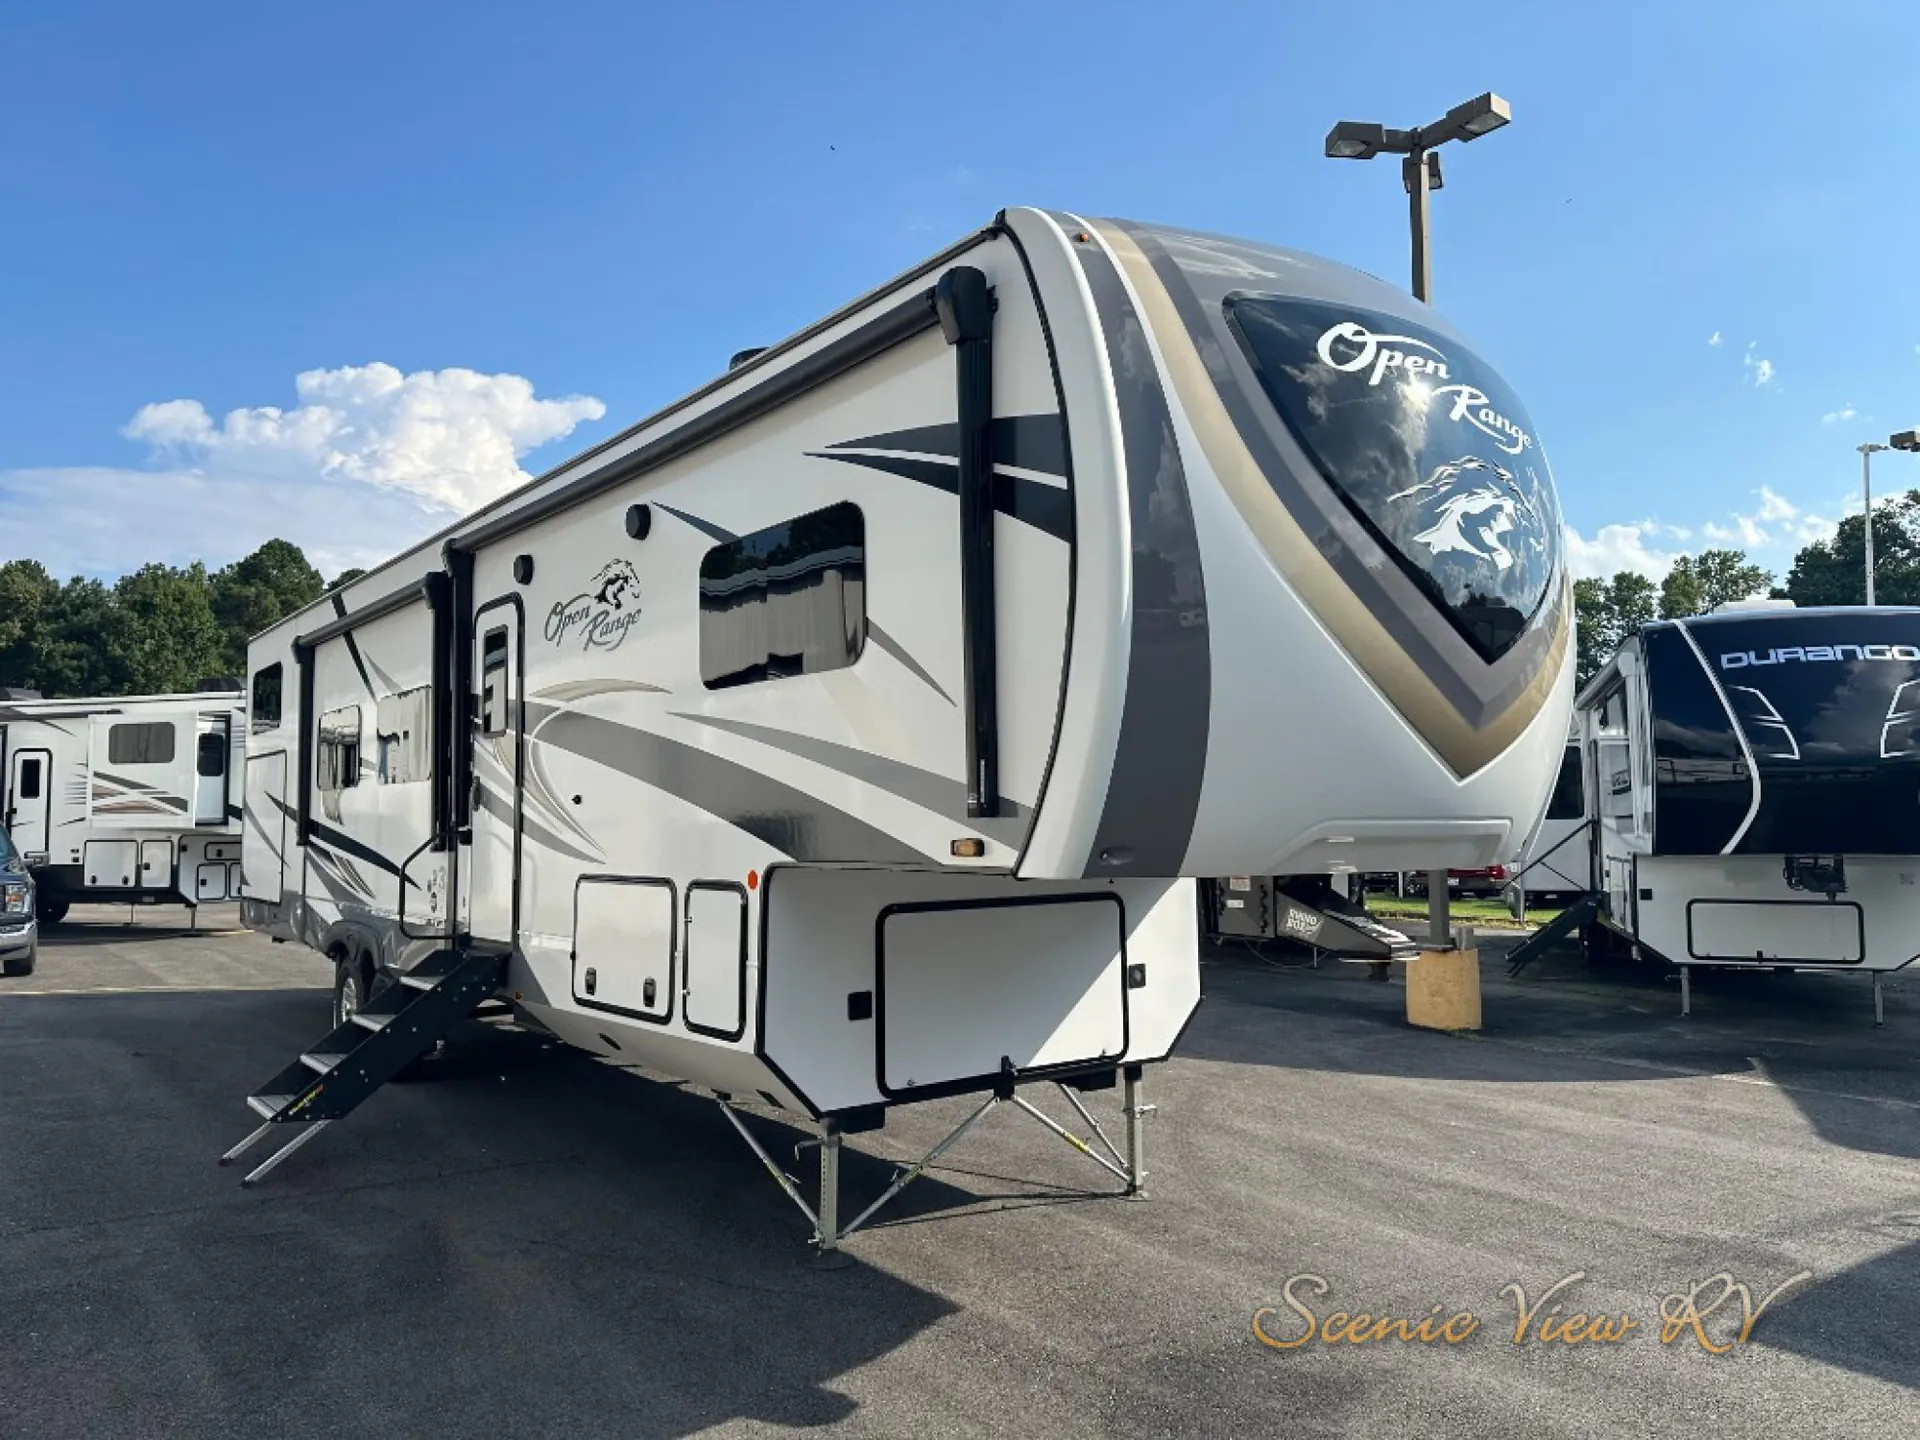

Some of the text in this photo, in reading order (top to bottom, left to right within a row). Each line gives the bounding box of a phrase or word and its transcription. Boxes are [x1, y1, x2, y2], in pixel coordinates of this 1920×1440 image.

[1317, 322, 1449, 385] Open
[1432, 384, 1532, 455] Range
[544, 593, 592, 647] Open
[578, 608, 642, 652] Range
